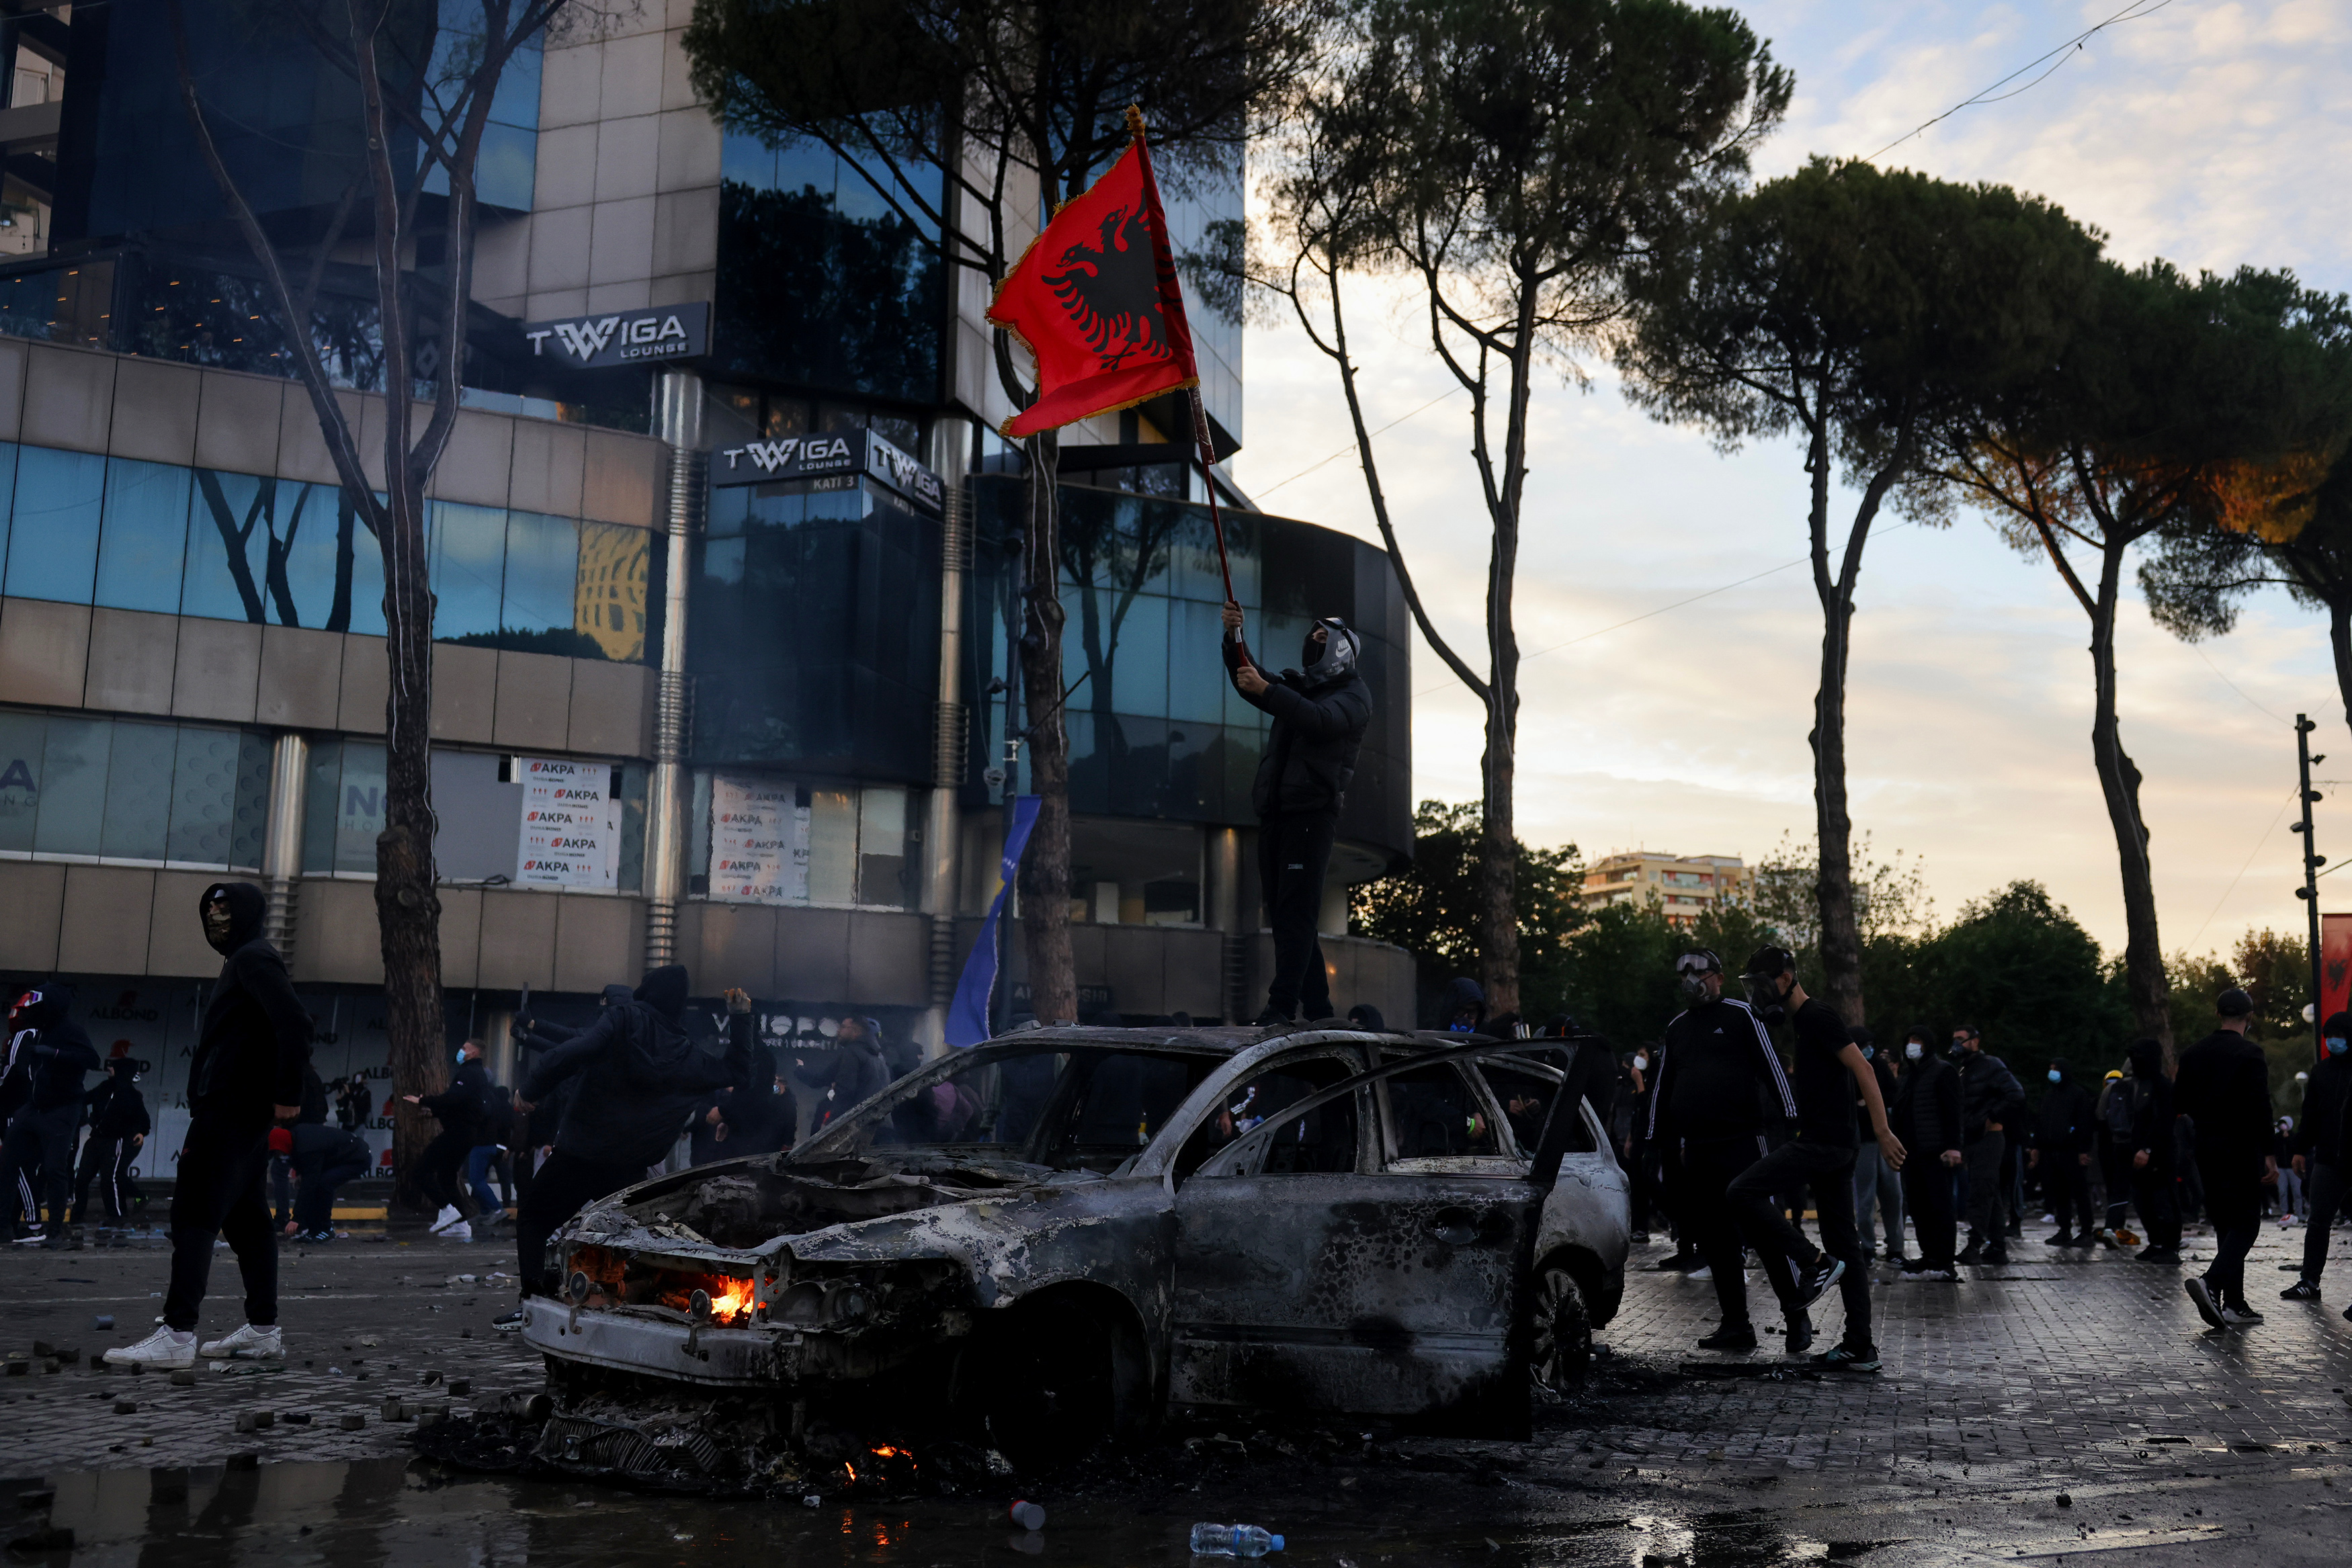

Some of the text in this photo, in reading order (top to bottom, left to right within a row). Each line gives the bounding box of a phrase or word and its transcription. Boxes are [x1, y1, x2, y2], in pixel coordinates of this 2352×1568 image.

[526, 315, 686, 361] TWIGA
[620, 342, 687, 359] LOUNGE
[723, 437, 851, 473] TWIGA
[847, 475, 854, 487] 3
[541, 763, 575, 775] AKPA
[566, 790, 599, 801] AKPA
[539, 812, 573, 824] AKPA
[731, 814, 762, 826] AKPA
[562, 838, 596, 849] AKPA
[755, 840, 785, 850] AKPA
[536, 861, 570, 872] AKPA
[729, 861, 761, 871] AKPA
[753, 886, 782, 897] AKPA
[90, 1006, 159, 1022] ALBOND
